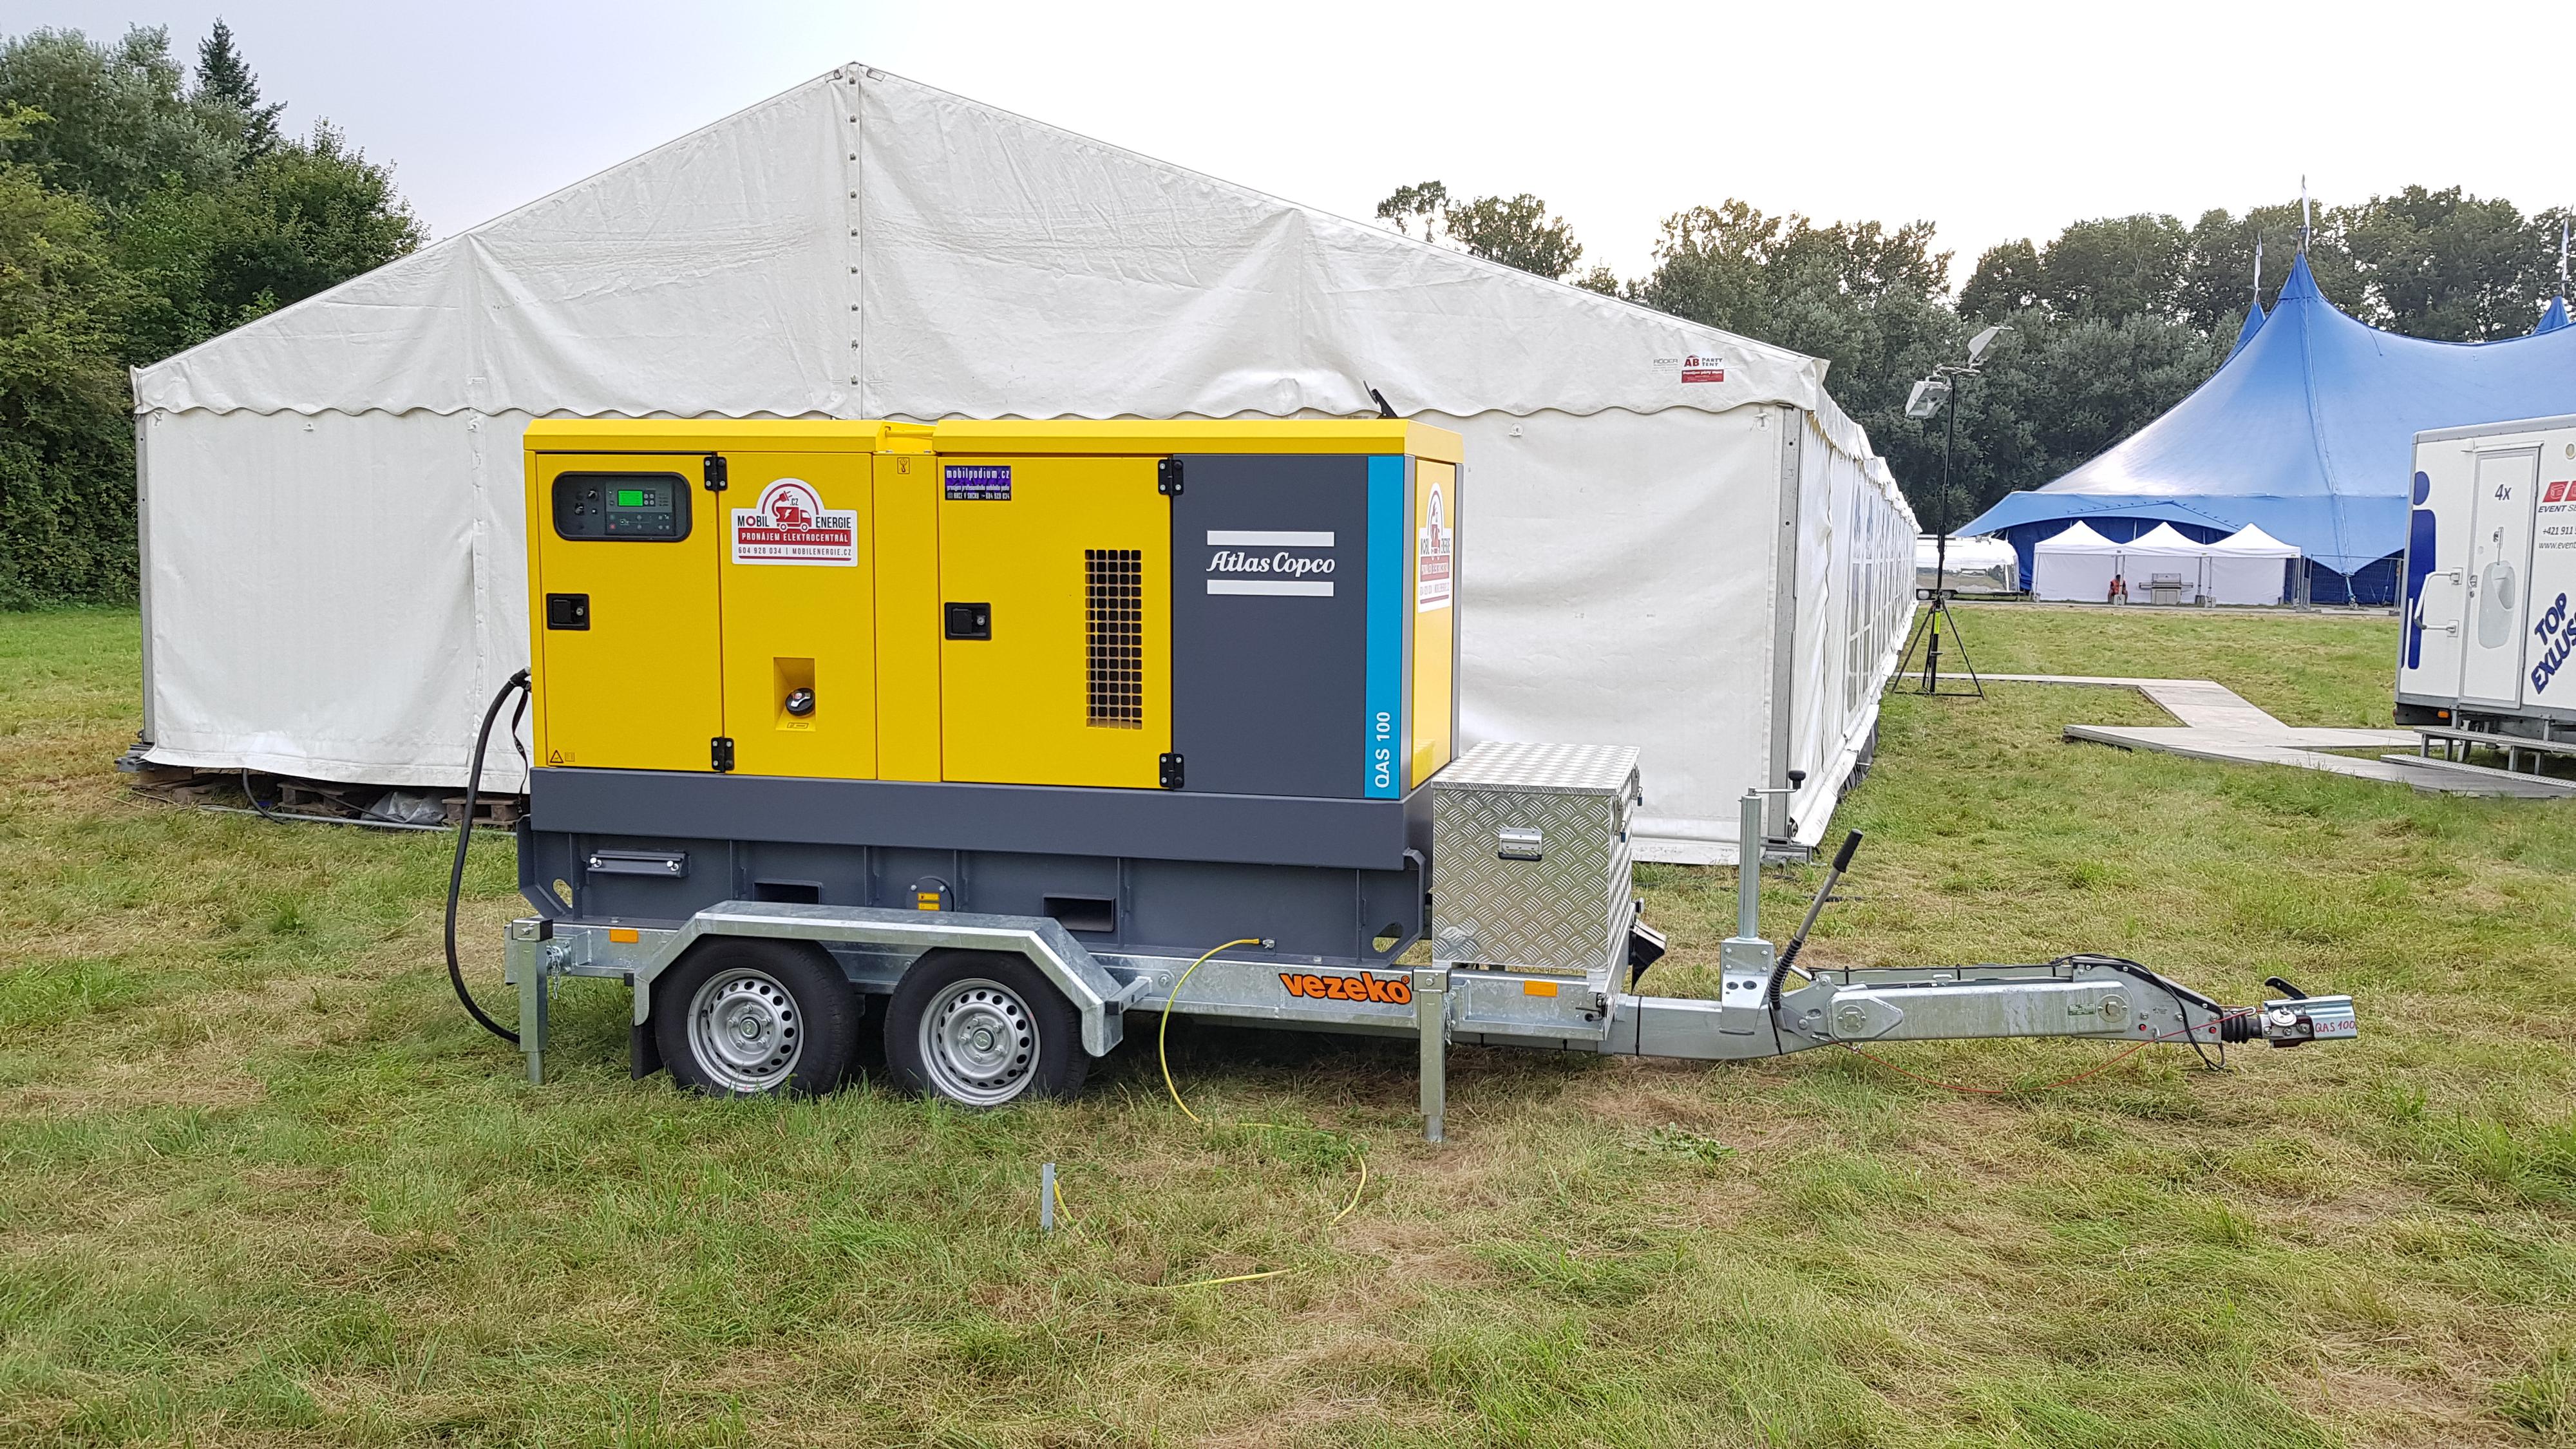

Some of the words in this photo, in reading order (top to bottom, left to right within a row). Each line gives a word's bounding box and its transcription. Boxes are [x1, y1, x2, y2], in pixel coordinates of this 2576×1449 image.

[1683, 359, 1700, 367] AB
[947, 467, 1010, 481] mobilpodium.cz
[2494, 484, 2512, 500] 4x
[737, 515, 770, 527] MOBIL
[815, 516, 851, 529] ENERGIE
[742, 531, 780, 541] PRONÁJEM
[783, 532, 848, 542] ELEKTROCENTRÁL
[2561, 526, 2573, 535] 911
[1206, 551, 1271, 573] Atlas
[1272, 551, 1336, 578] Copco
[2534, 592, 2567, 645] TOP
[2531, 612, 2576, 695] EXLUS
[1376, 712, 1390, 742] 100
[1375, 748, 1390, 788] QAS
[2315, 1022, 2336, 1033] QAS
[2338, 1020, 2356, 1030] 100
